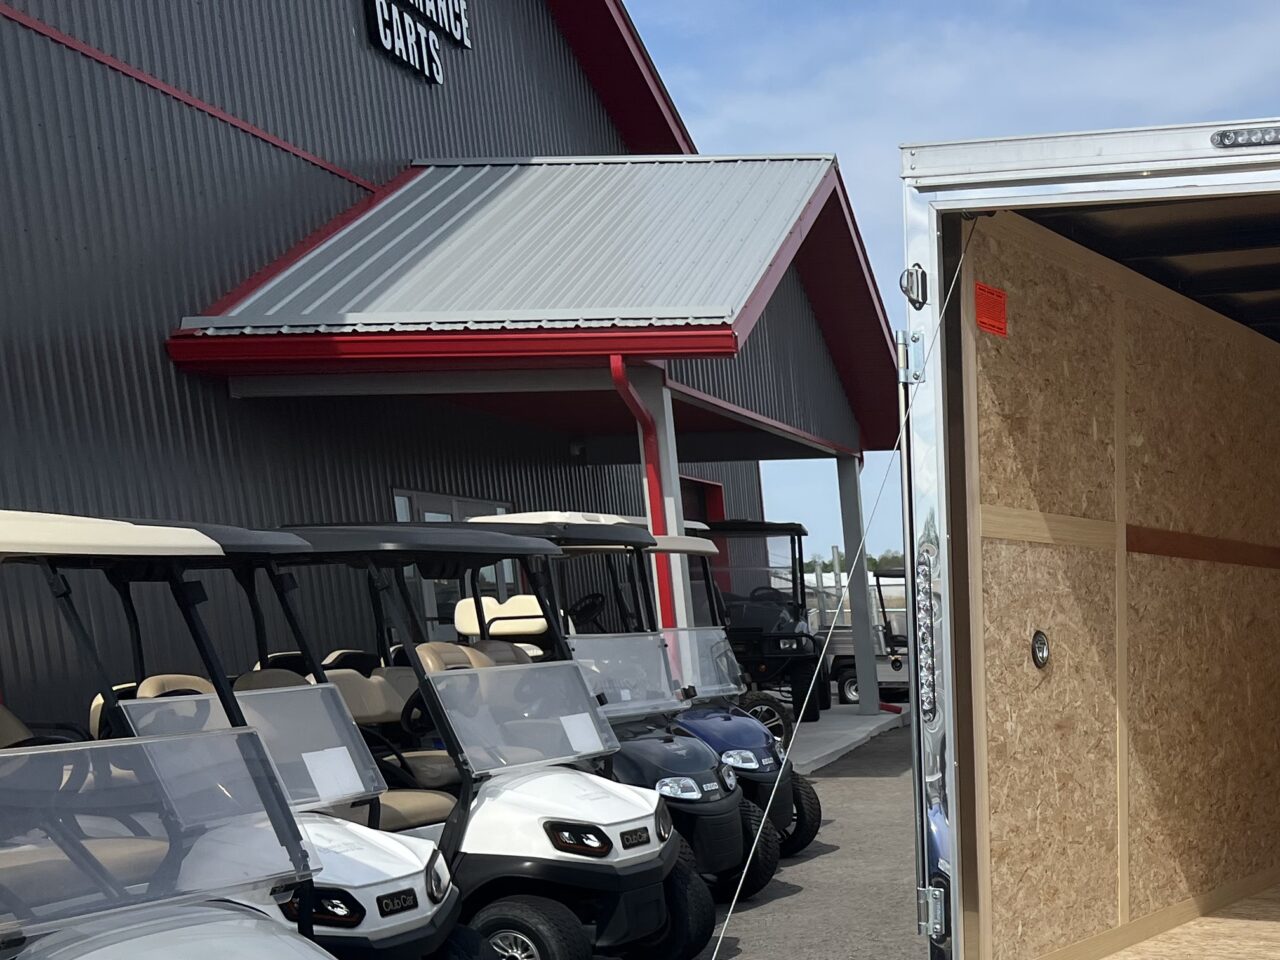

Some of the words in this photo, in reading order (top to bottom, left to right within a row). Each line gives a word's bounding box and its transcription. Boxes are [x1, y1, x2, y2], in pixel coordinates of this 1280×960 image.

[375, 0, 444, 85] CARTS
[382, 897, 401, 912] Club
[400, 895, 414, 907] Car
